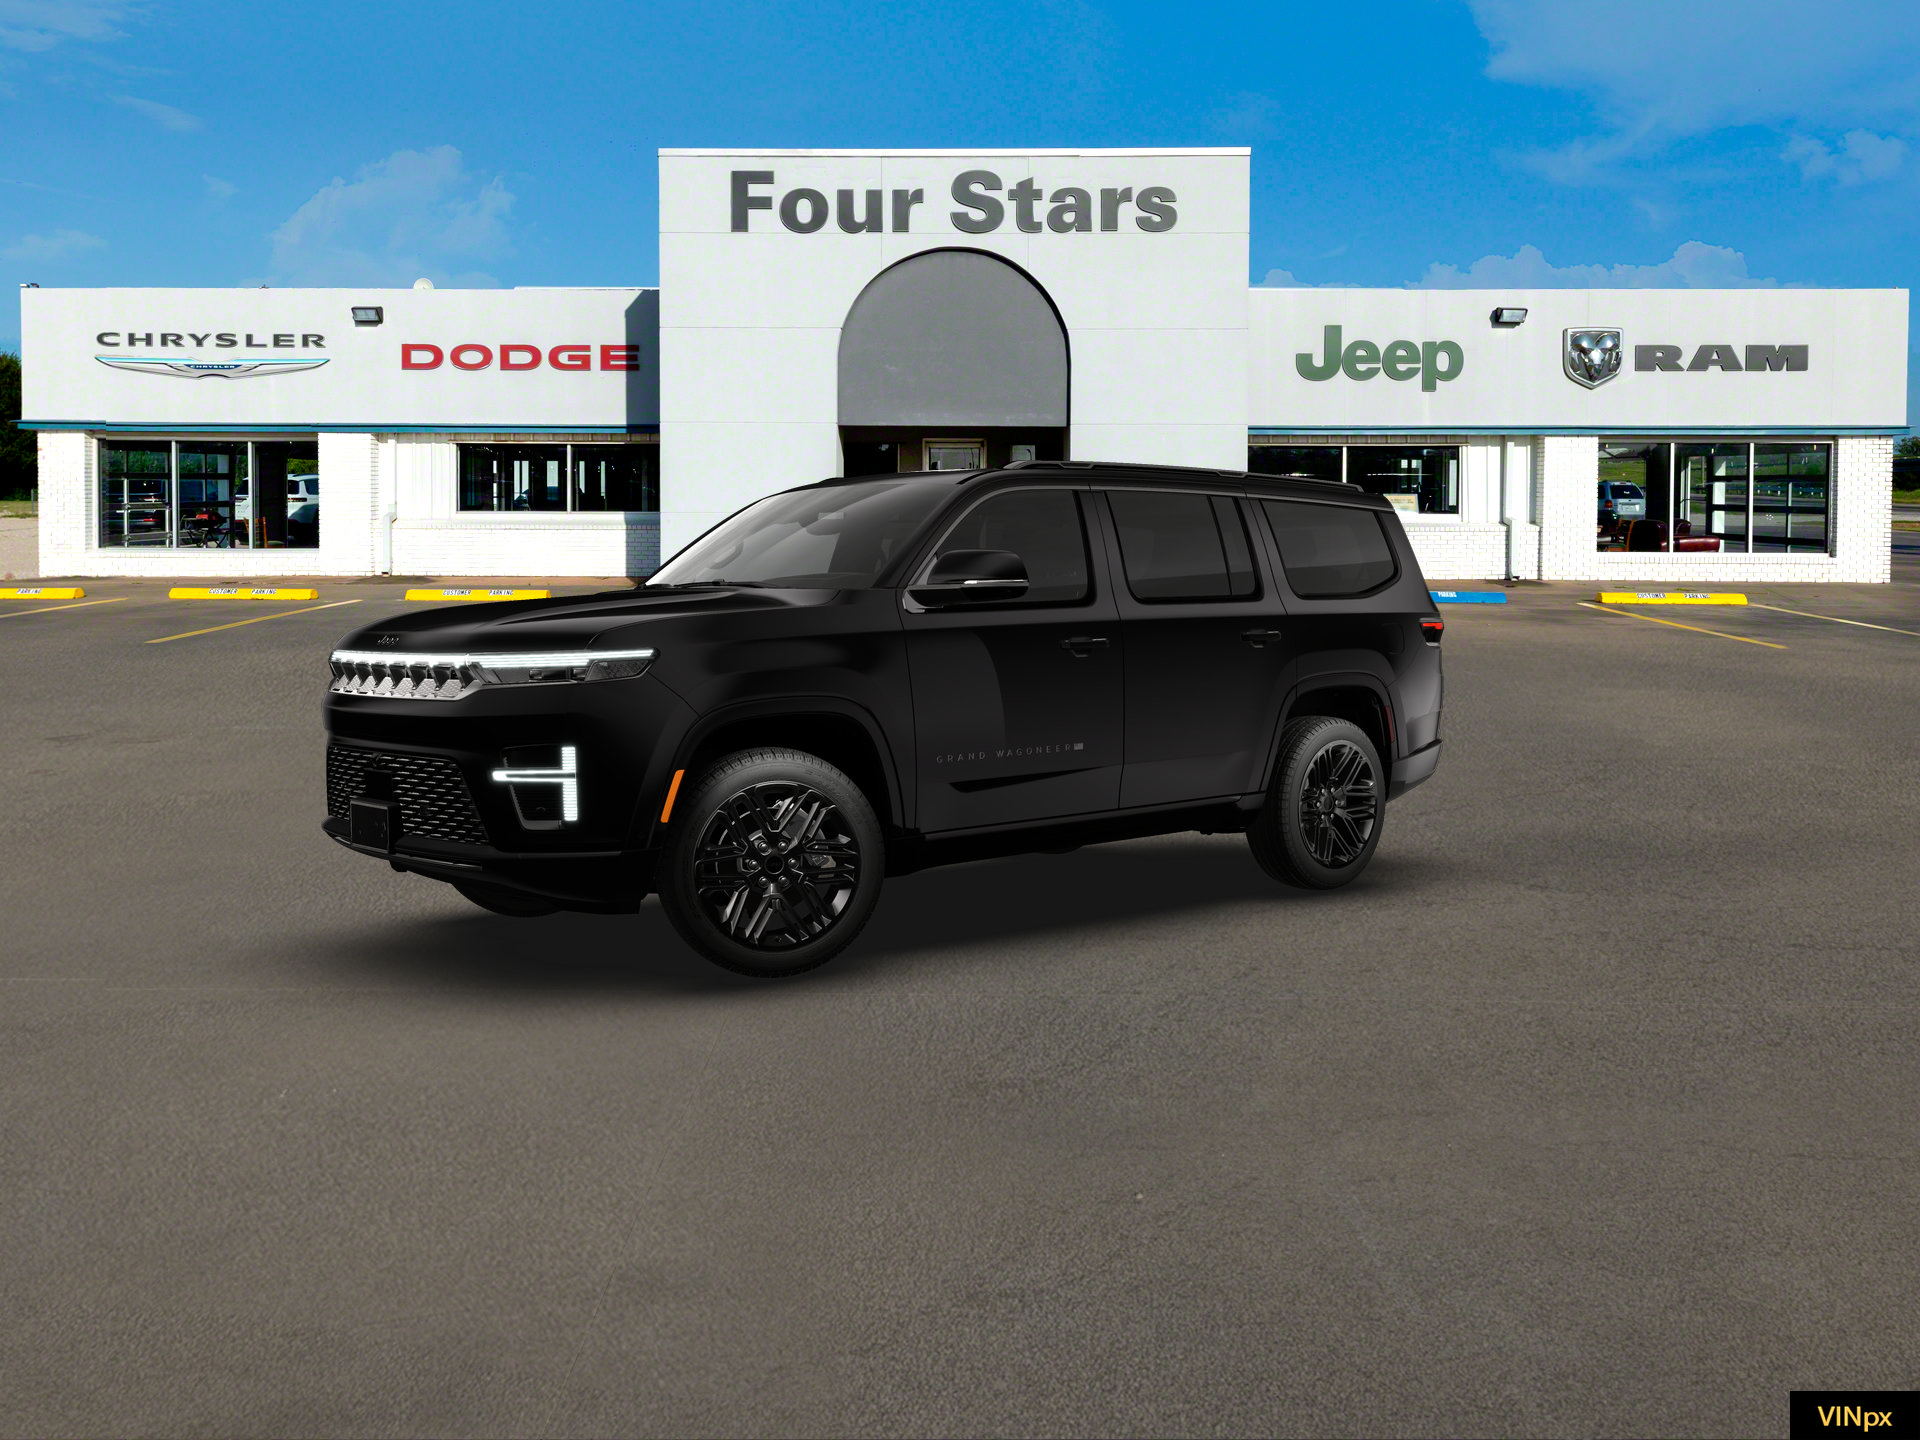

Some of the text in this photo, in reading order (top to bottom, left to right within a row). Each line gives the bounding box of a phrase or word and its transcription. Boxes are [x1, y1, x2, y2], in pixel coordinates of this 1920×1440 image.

[730, 170, 1178, 234] Four Stars
[96, 331, 327, 349] CHRYSLER
[401, 343, 640, 371] DODGE
[1296, 325, 1464, 392] Jeep
[1635, 344, 1809, 372] RAM
[936, 743, 1071, 764] GRAND WAGONEER
